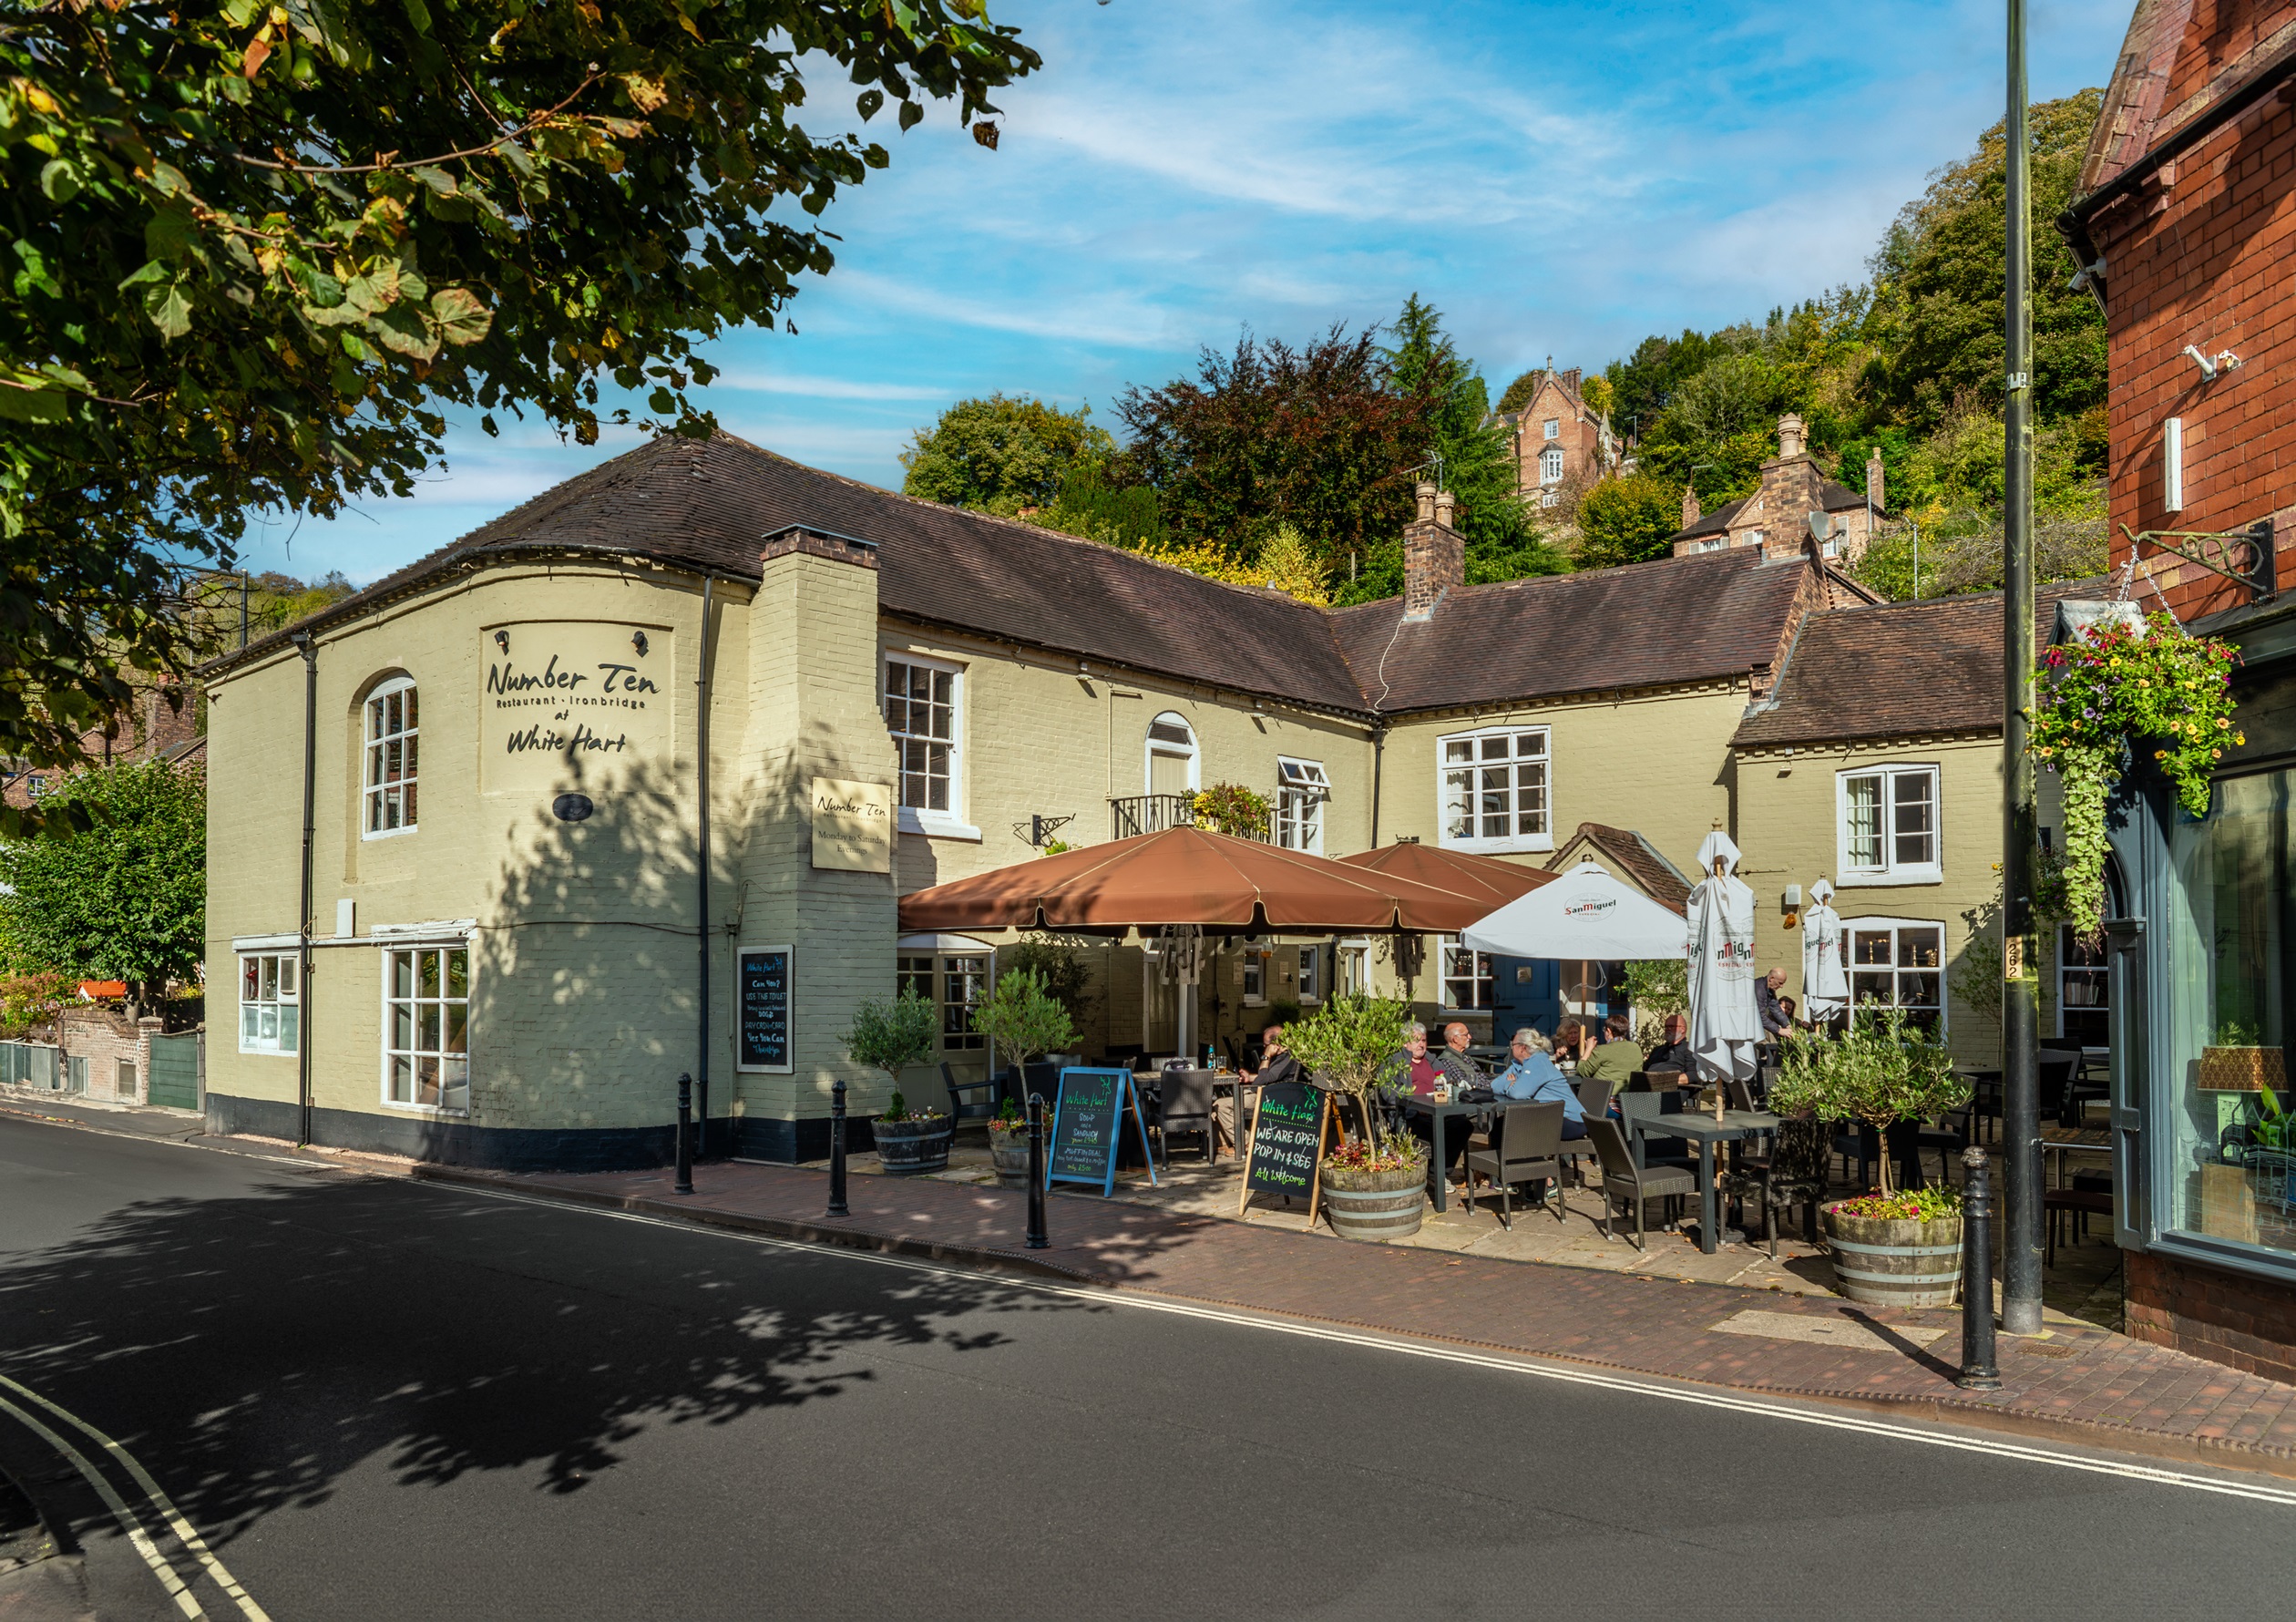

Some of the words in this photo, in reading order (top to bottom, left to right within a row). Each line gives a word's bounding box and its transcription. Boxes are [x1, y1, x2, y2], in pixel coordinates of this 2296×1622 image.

[487, 654, 589, 694] Number
[597, 663, 661, 694] Ten
[497, 695, 556, 709] Restaurant
[569, 695, 645, 710] Ironbridge
[554, 709, 569, 721] at
[507, 724, 566, 755] White
[569, 723, 627, 756] Hart
[817, 796, 862, 814] Number
[866, 803, 887, 816] Ten
[818, 830, 848, 844] Monday
[857, 834, 887, 847] Saturday
[837, 844, 868, 857] Evenings
[2009, 943, 2017, 978] 262
[752, 980, 765, 988] Can
[746, 992, 756, 1001] USE
[757, 992, 768, 1001] THE
[769, 992, 787, 1001] TOILET
[745, 1021, 756, 1030] PAY
[756, 1021, 770, 1030] CASH
[772, 1021, 785, 1030] CARD
[747, 1032, 759, 1042] Yes
[771, 1032, 785, 1042] Can
[1066, 1090, 1089, 1105] White
[1090, 1093, 1108, 1108] Hart
[1079, 1113, 1096, 1122] SOUP
[1261, 1099, 1289, 1117] White
[1291, 1104, 1316, 1122] Hart
[1073, 1127, 1099, 1138] SANDWICH
[1256, 1126, 1273, 1140] WE
[1274, 1129, 1295, 1144] ARE
[1295, 1131, 1319, 1148] OPEN
[1064, 1147, 1088, 1156] MUFFIN
[1088, 1149, 1102, 1157] DEAL
[1253, 1142, 1273, 1158] POP
[1273, 1148, 1286, 1162] IN
[1286, 1151, 1293, 1165] &
[1293, 1153, 1312, 1169] SEE
[1255, 1166, 1269, 1182] All
[1270, 1169, 1307, 1186] Welcome
